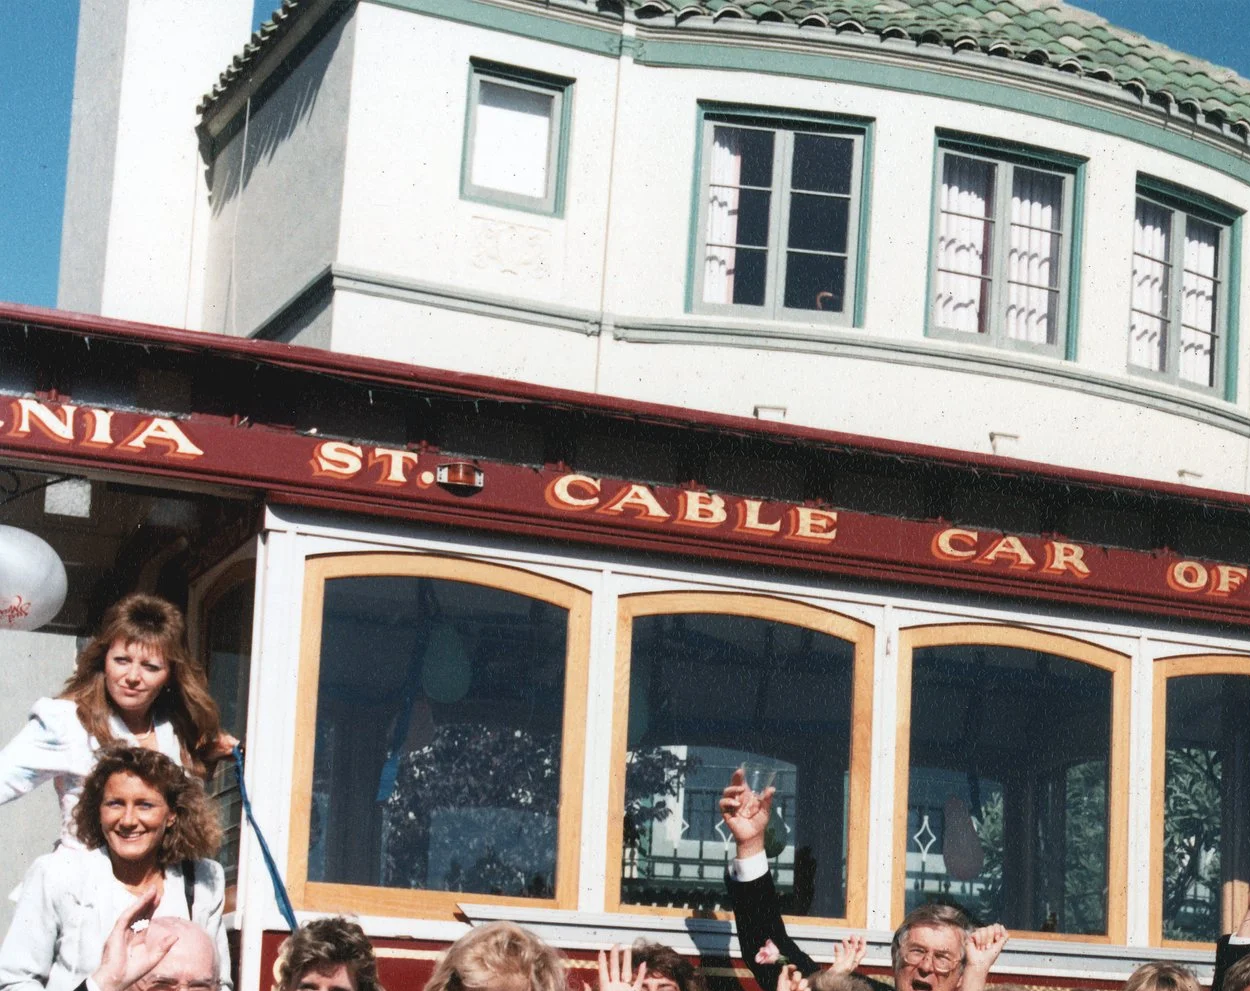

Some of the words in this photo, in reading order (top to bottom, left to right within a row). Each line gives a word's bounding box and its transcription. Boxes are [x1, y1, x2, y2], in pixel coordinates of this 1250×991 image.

[0, 398, 205, 460] NIA
[310, 440, 435, 489] ST.
[546, 473, 839, 545] CABLE
[930, 527, 1091, 579] CAR
[1167, 560, 1249, 595] OF
